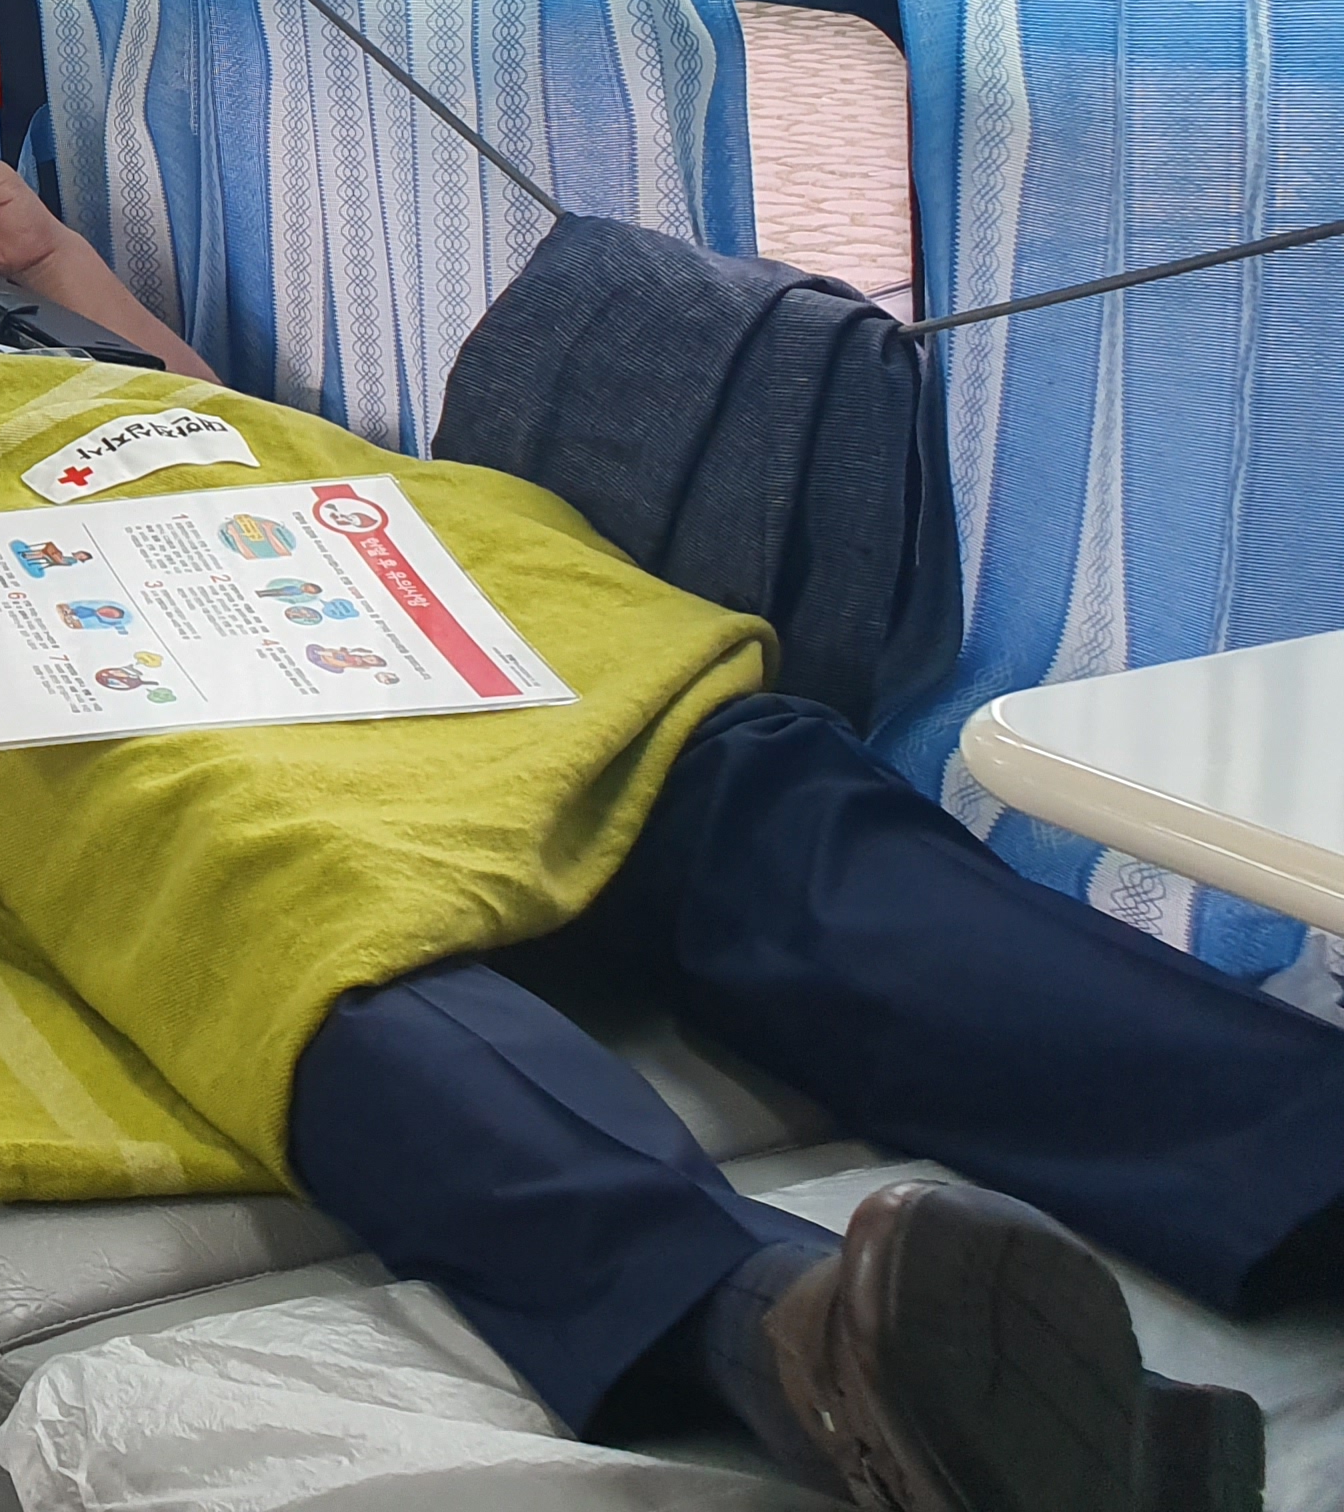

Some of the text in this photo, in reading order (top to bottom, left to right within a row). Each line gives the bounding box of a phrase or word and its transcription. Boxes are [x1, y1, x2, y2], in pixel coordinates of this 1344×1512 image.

[76, 416, 229, 460] 대한적십자사
[359, 537, 390, 557] 헌혈
[377, 558, 398, 569] 후
[210, 574, 232, 584] 2
[144, 580, 164, 589] 3
[385, 570, 431, 607] 유의사항
[7, 591, 27, 600] 6
[261, 639, 280, 647] 4
